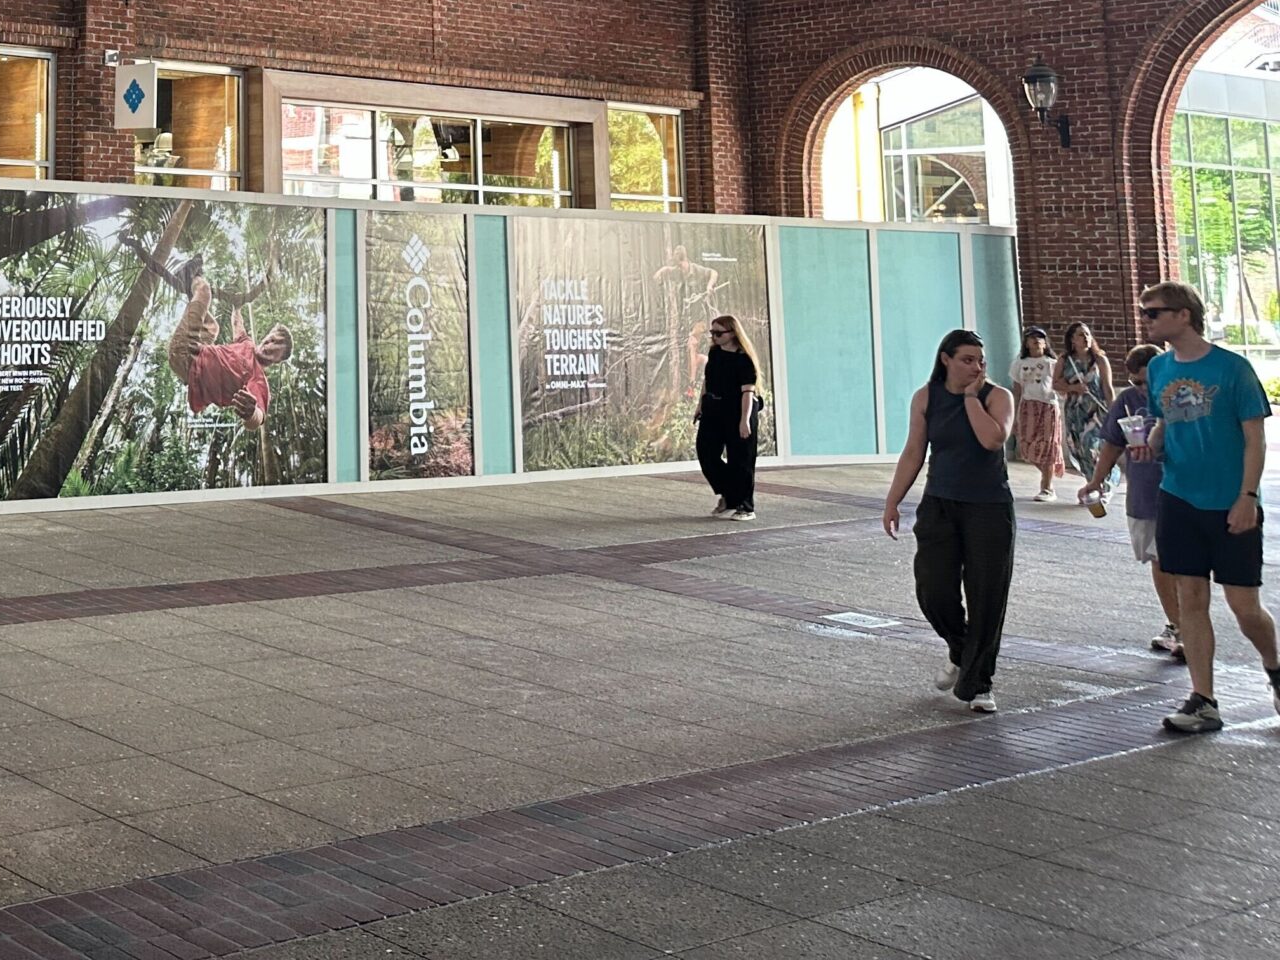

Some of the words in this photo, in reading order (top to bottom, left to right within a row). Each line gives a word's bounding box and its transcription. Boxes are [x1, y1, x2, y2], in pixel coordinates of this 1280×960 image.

[543, 279, 589, 301] TACKLE
[543, 304, 604, 326] NATURE'S
[543, 328, 609, 351] TOUGHEST
[405, 276, 435, 456] Columbia
[544, 353, 600, 376] TERRAIN
